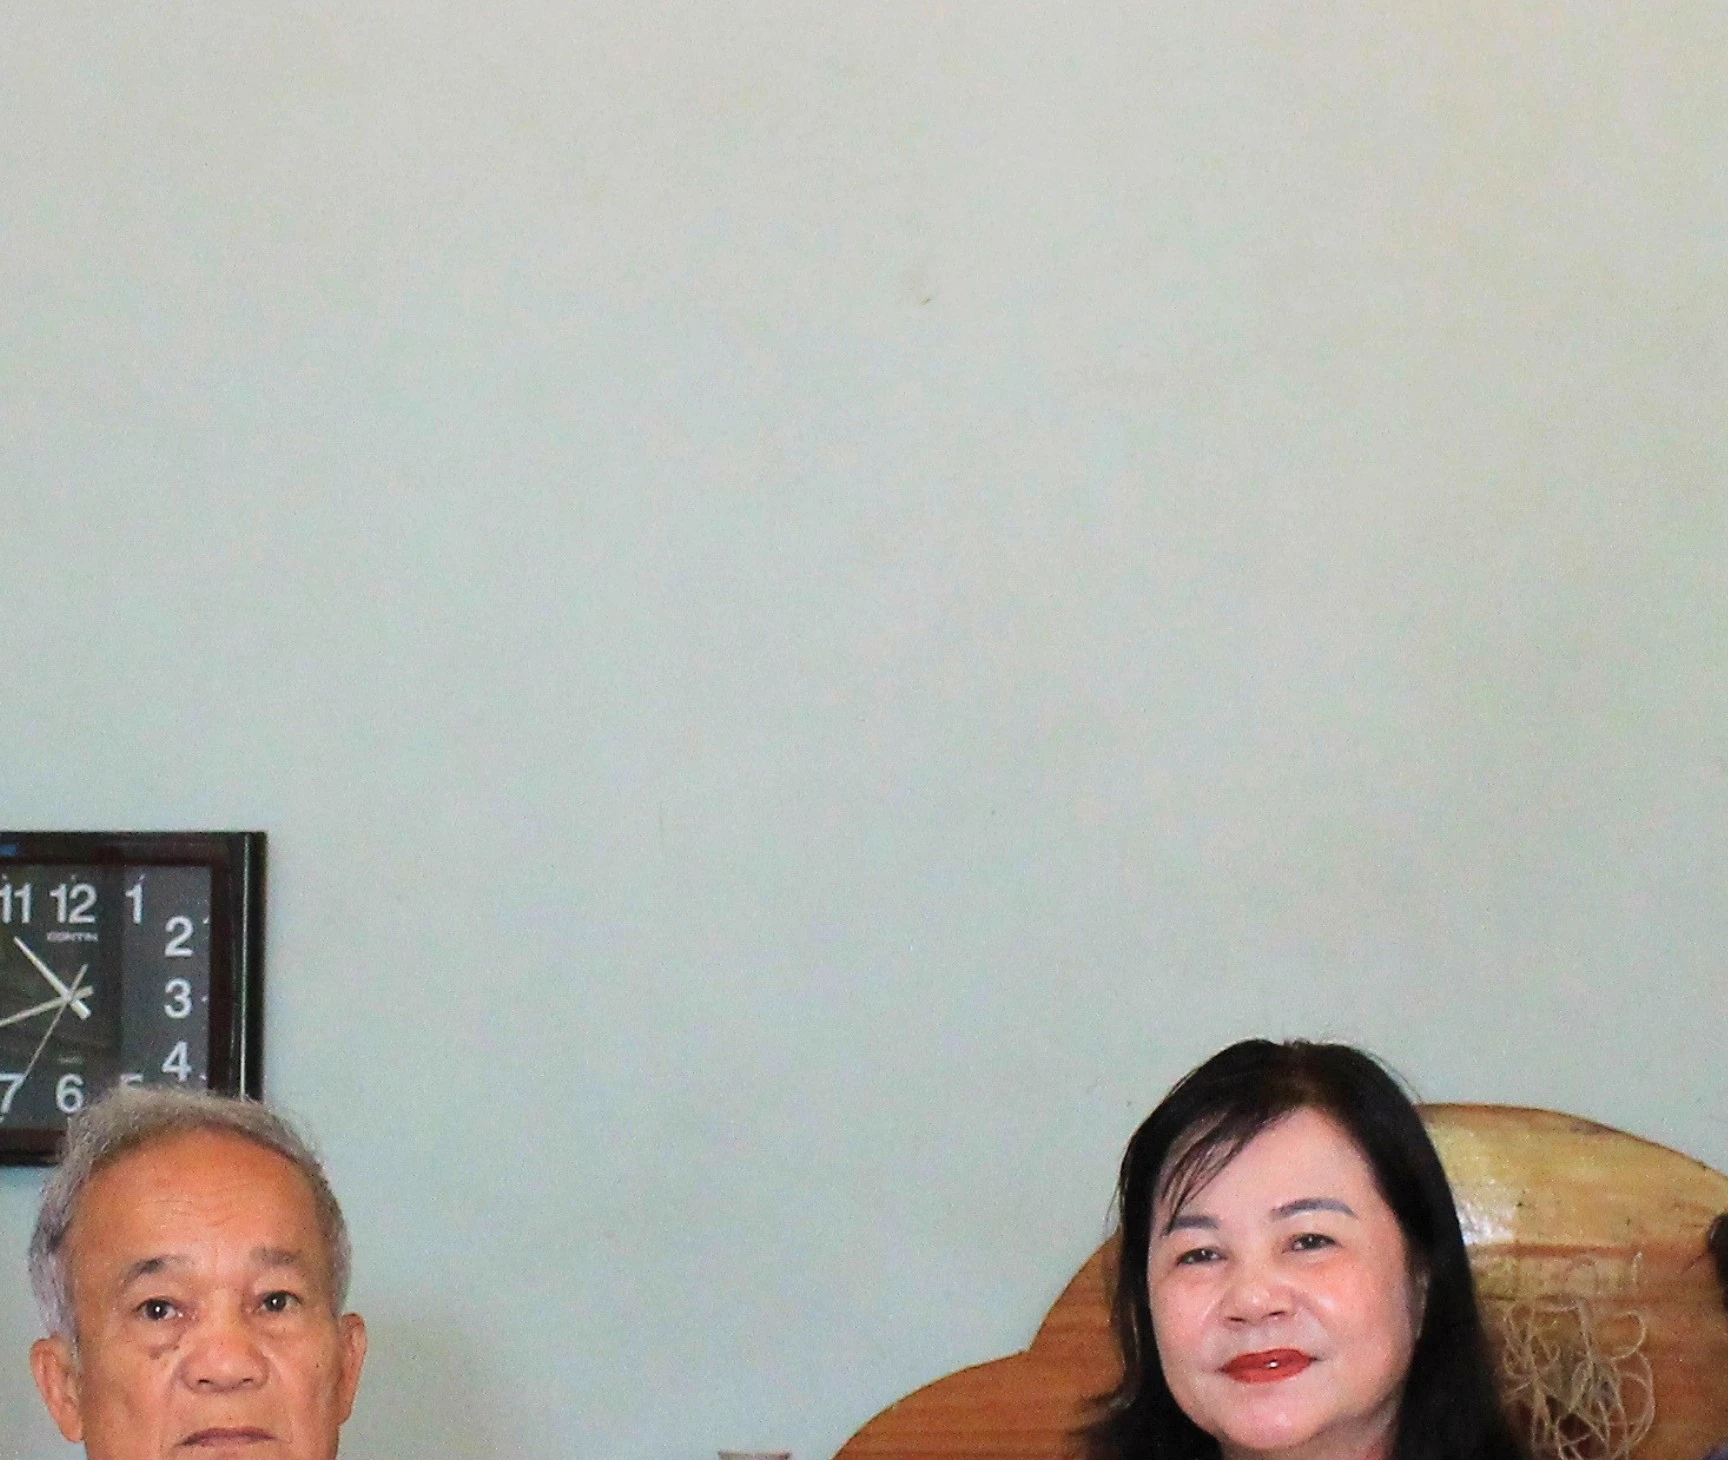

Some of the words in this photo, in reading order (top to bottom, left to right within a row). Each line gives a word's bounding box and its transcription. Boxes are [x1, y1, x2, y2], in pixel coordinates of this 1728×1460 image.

[49, 883, 98, 925] 12
[125, 883, 144, 925] 1
[164, 916, 195, 958] 2
[164, 978, 193, 1020] 3
[161, 1041, 192, 1082] 4
[55, 1073, 84, 1114] 6
